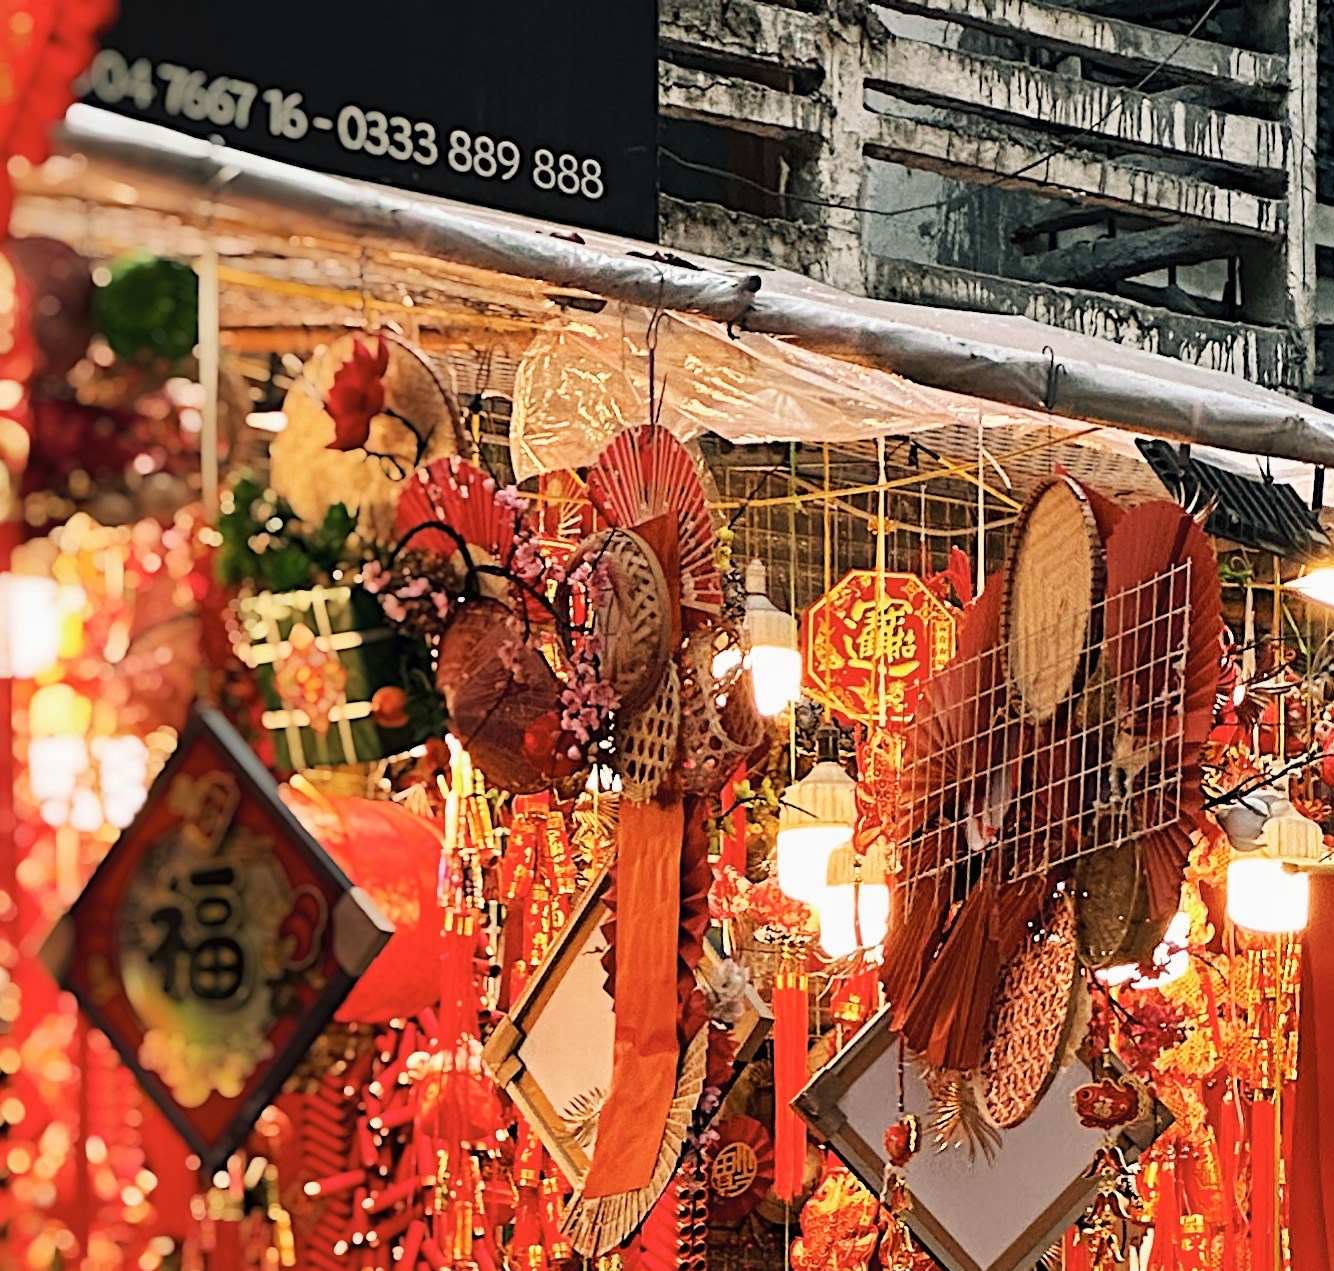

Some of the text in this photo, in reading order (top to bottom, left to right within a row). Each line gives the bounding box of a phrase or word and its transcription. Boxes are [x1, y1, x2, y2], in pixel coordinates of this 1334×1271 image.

[448, 130, 520, 180] 889
[532, 149, 604, 199] 888
[148, 866, 245, 1000] 福
